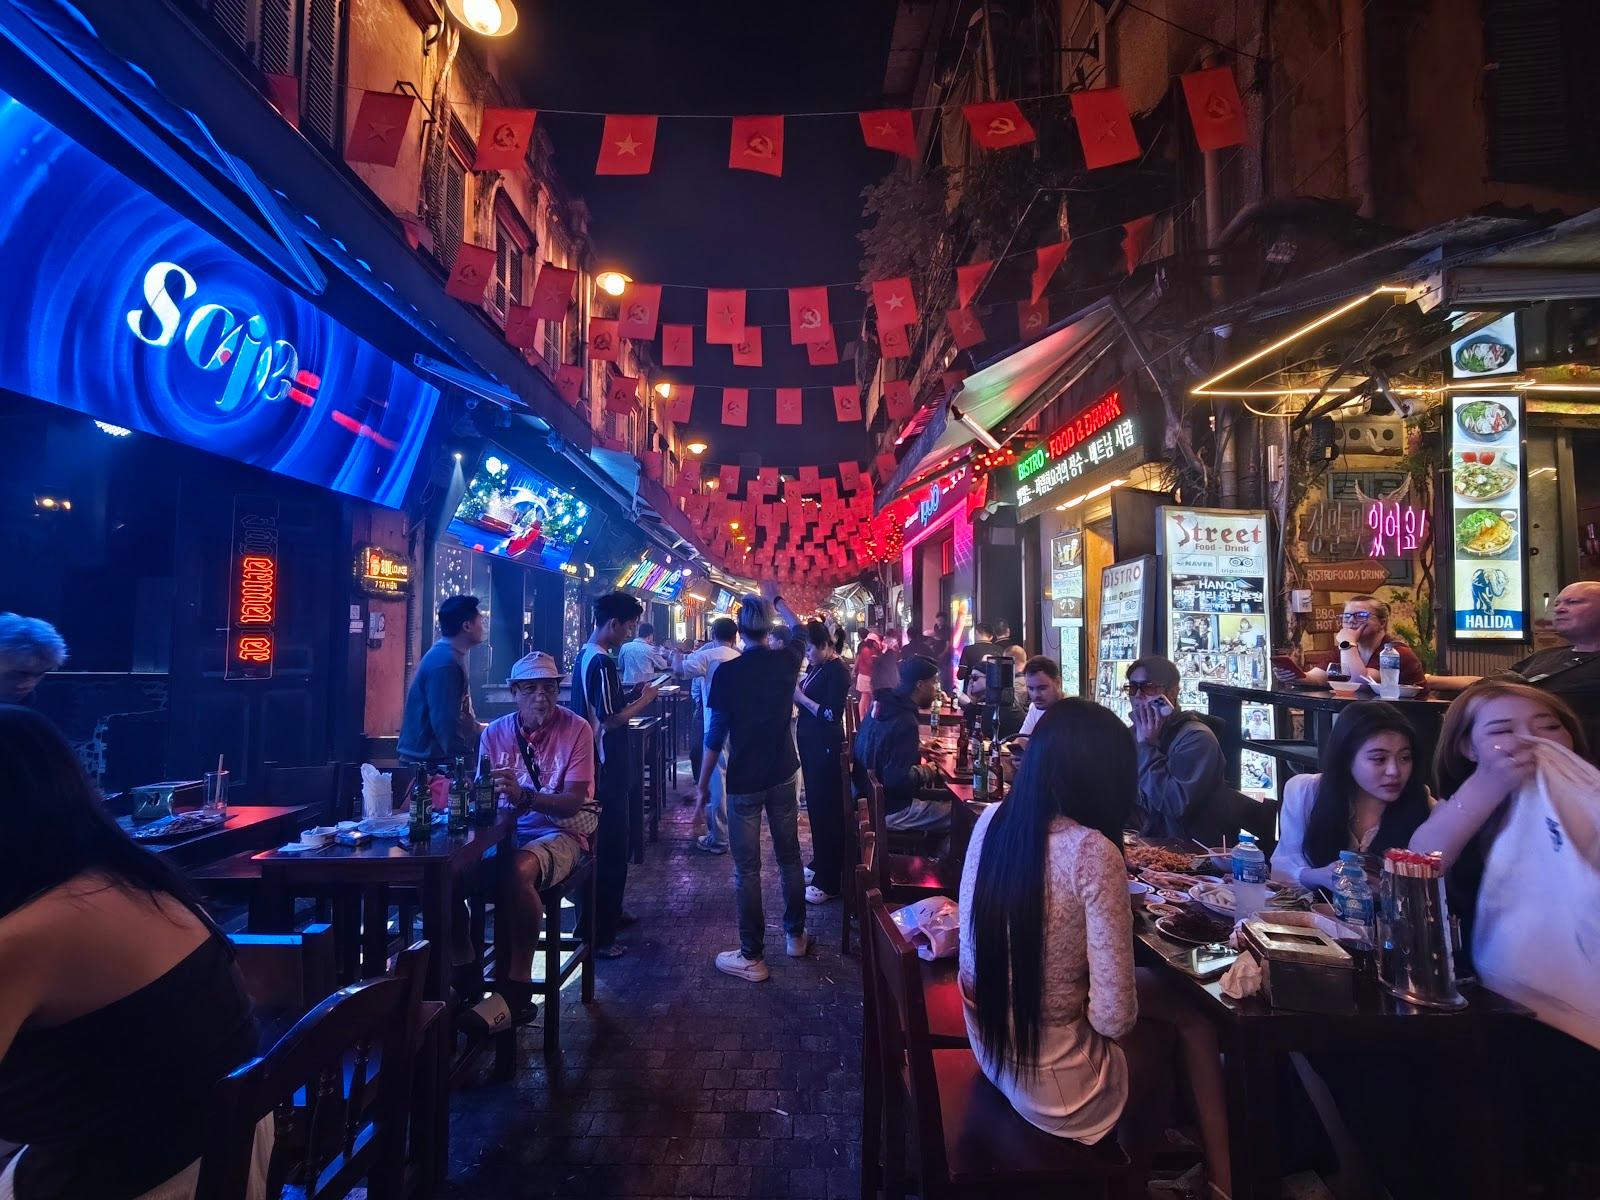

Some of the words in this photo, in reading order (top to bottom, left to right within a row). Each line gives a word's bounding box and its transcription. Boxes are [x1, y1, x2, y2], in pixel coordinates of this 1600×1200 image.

[1017, 449, 1045, 481] BISTRO
[1049, 426, 1076, 459] FOOD
[1076, 421, 1086, 442] &
[1085, 392, 1122, 436] DRINK
[1115, 419, 1135, 450] 사람
[1195, 543, 1216, 551] Food
[1224, 544, 1250, 552] Drink
[1103, 565, 1142, 588] BISTRO
[1360, 569, 1386, 580] DRINK
[1315, 609, 1336, 620] BBQ
[1316, 621, 1333, 630] HOT
[1465, 615, 1514, 629] HALIDA
